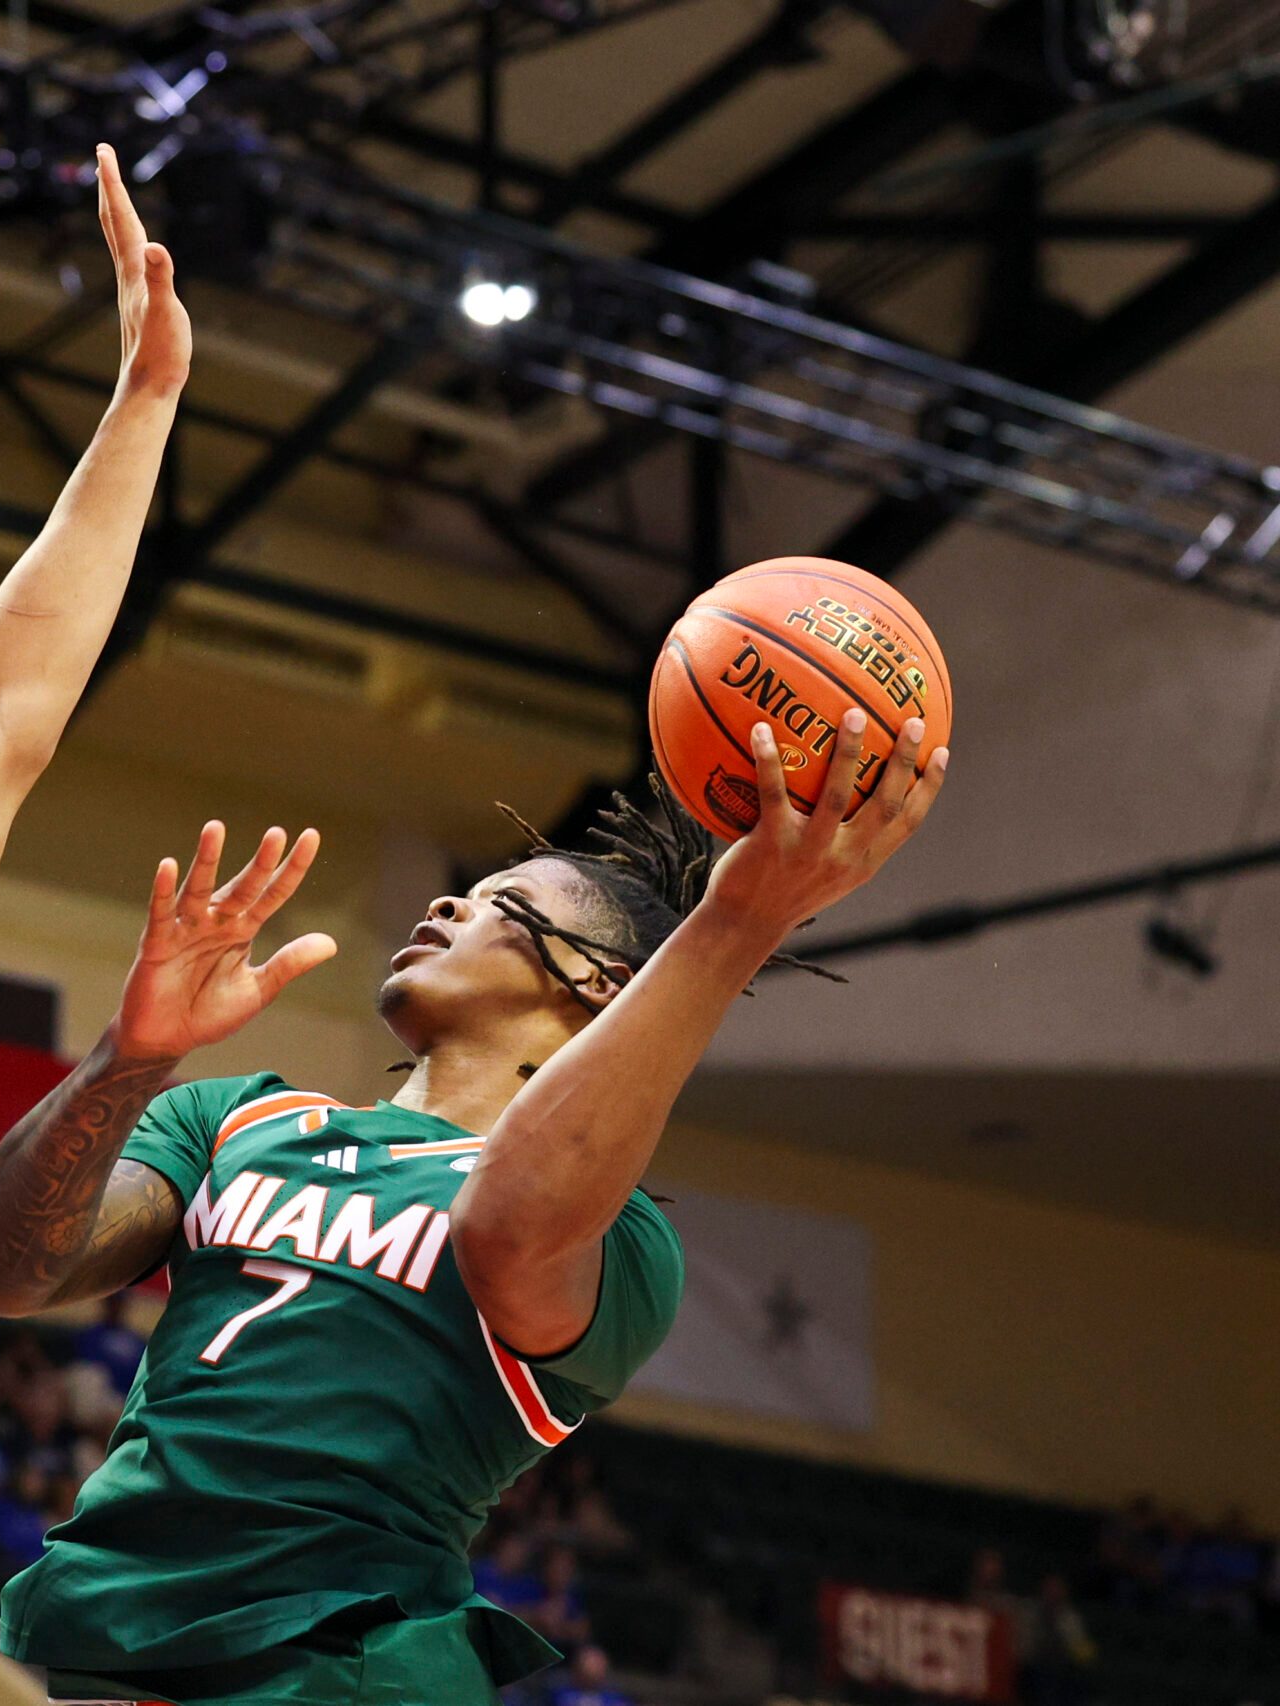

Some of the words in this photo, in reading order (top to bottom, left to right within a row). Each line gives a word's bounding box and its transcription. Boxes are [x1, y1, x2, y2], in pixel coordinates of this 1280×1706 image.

[785, 606, 926, 719] LEGACY
[183, 1170, 450, 1293] MIAMI
[198, 1259, 314, 1367] 7
